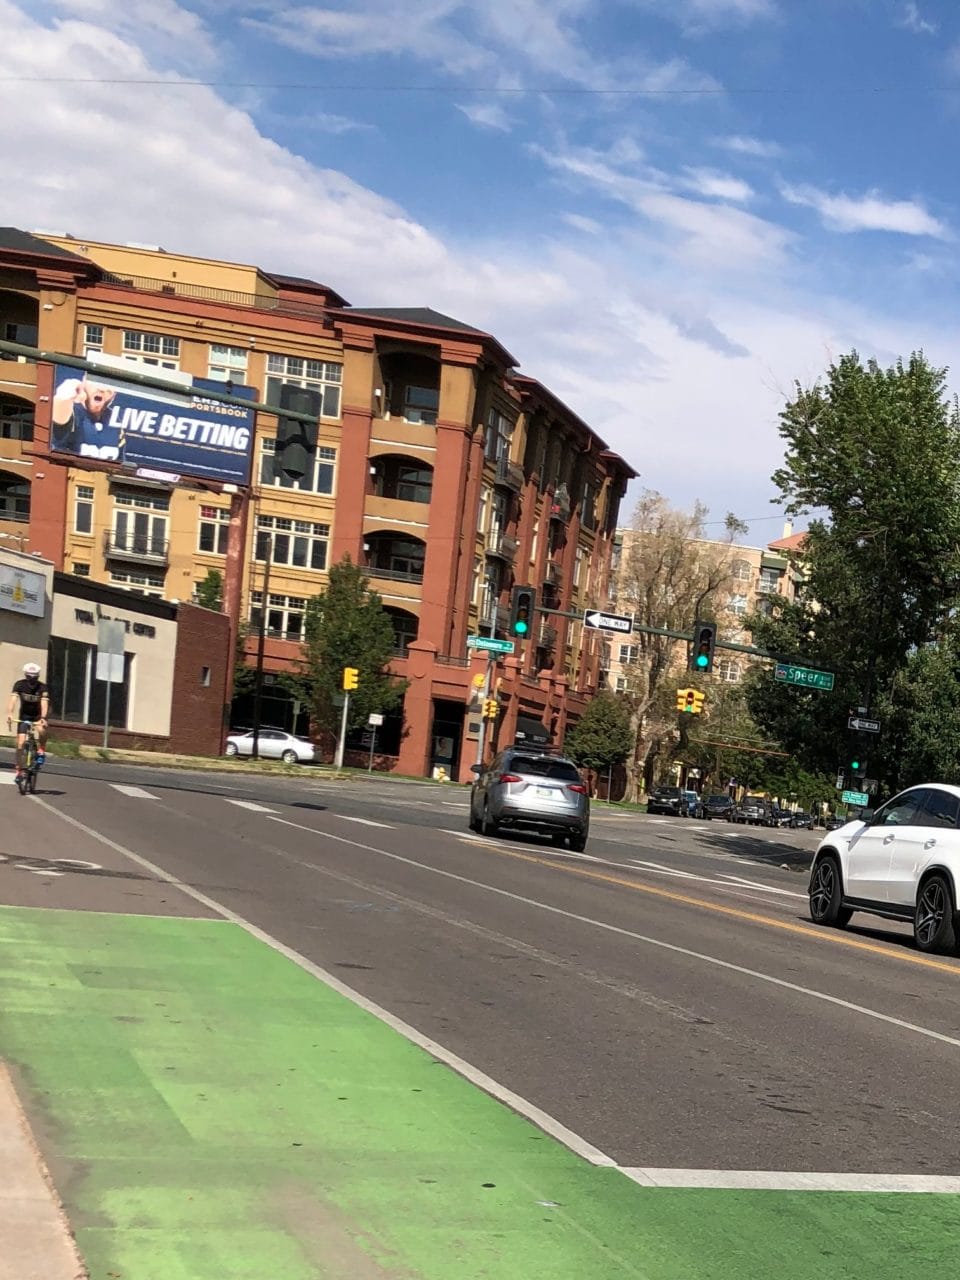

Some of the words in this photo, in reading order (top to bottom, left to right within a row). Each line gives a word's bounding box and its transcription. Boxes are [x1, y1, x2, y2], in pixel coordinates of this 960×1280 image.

[191, 402, 248, 418] PORTSBOOK
[108, 405, 159, 434] LIVE
[158, 414, 250, 450] BETTING
[599, 617, 611, 626] ONE
[613, 620, 628, 630] WAY
[788, 668, 818, 682] Speer
